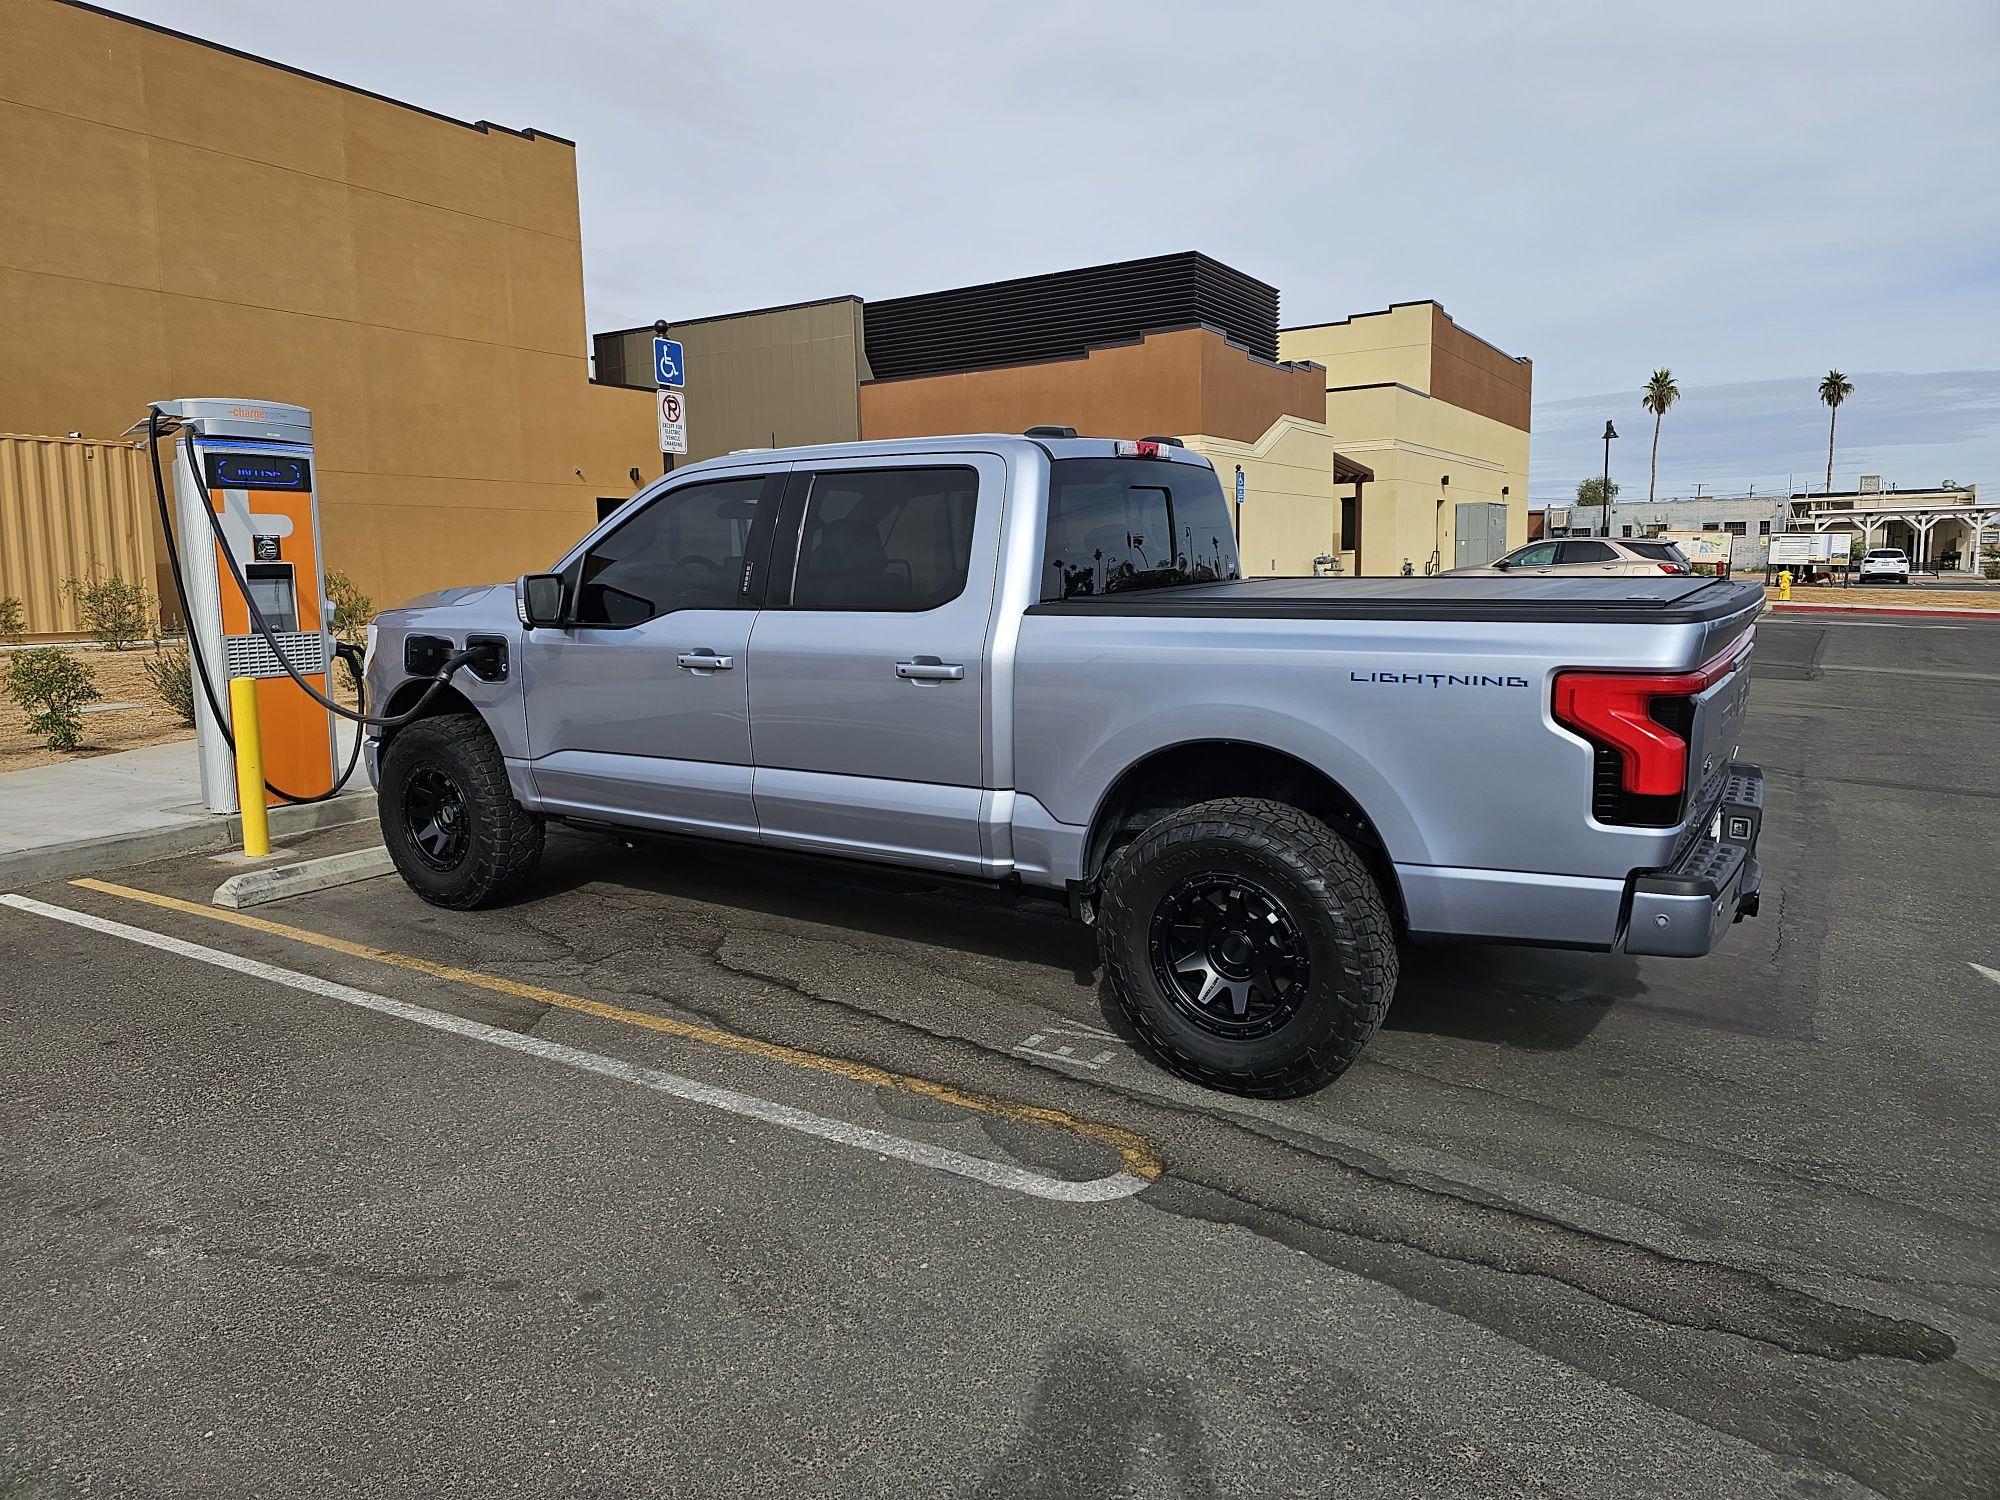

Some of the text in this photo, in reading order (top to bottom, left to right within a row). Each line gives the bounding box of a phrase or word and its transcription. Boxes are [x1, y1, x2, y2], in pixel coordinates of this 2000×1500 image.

[664, 428, 681, 436] ELECTRIC
[664, 440, 683, 448] CHARGING
[1350, 671, 1529, 688] LIGHTNING
